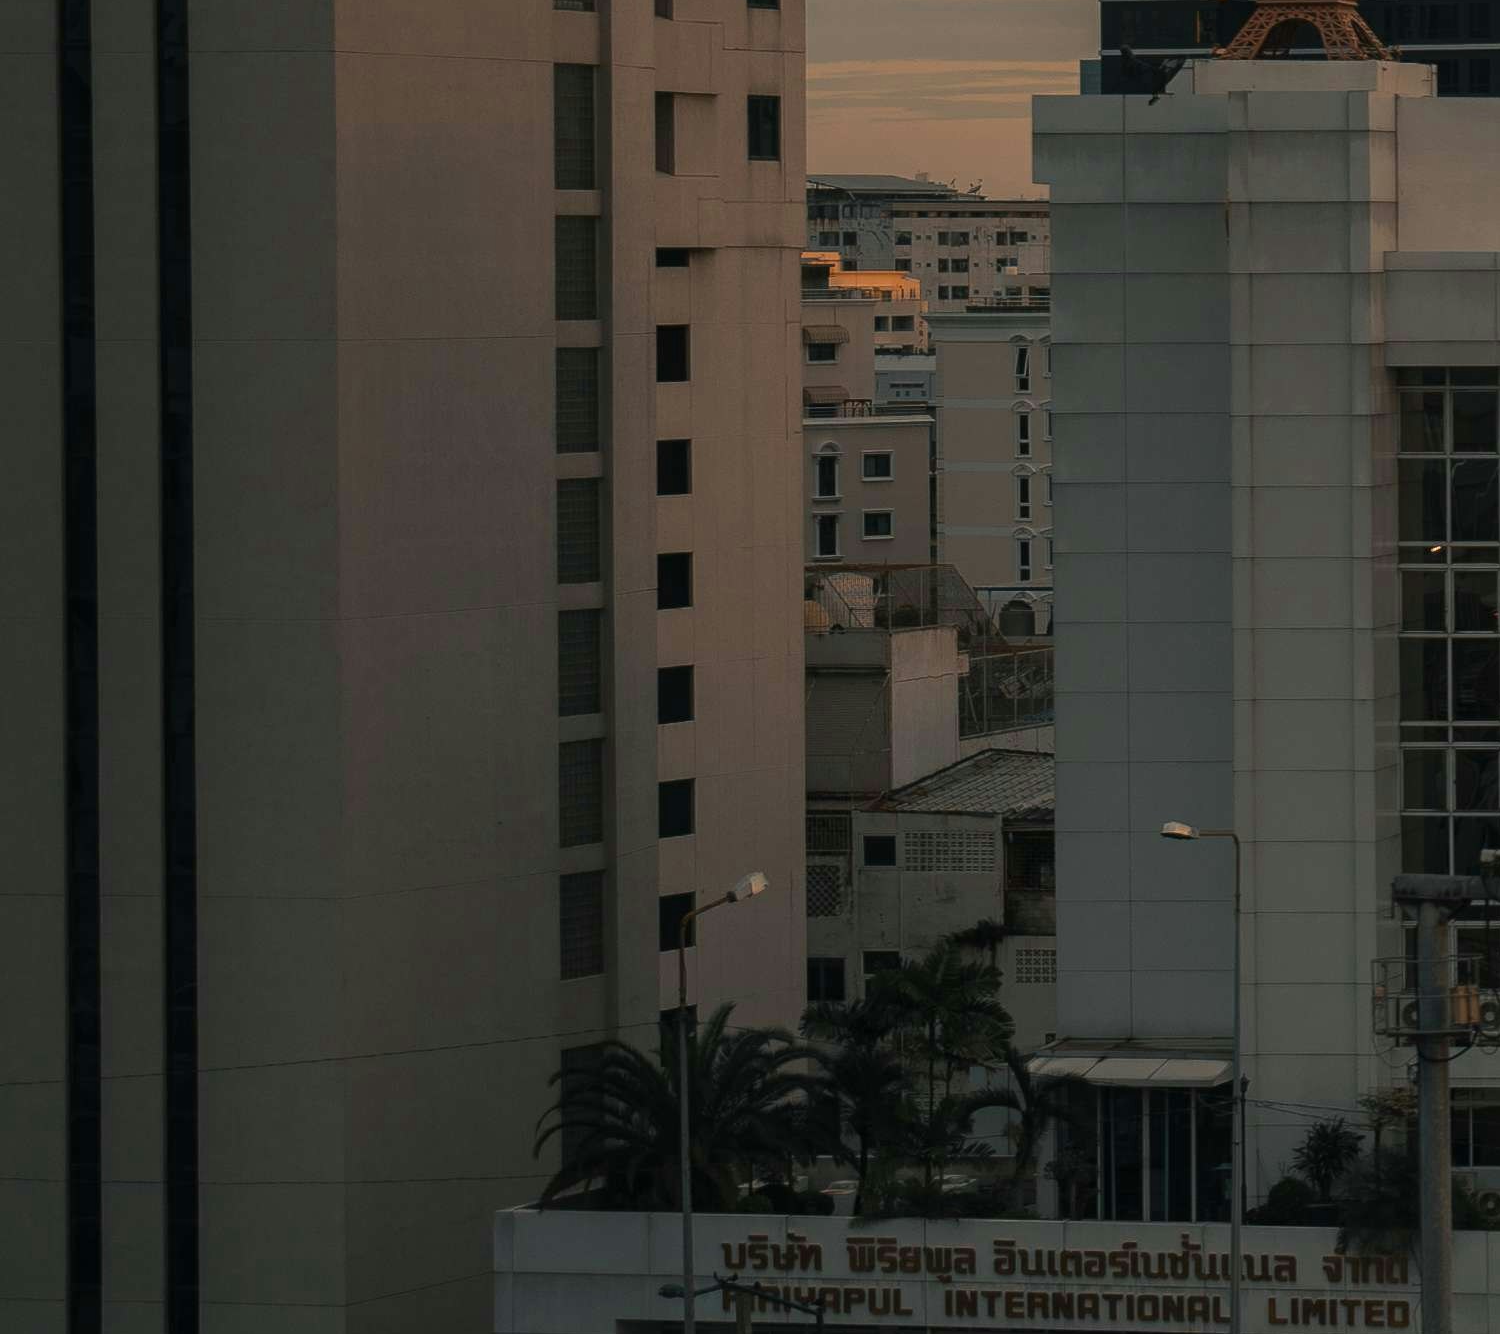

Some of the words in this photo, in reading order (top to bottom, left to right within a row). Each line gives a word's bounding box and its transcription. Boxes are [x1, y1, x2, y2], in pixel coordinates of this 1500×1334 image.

[720, 1227, 823, 1272] บริษัท
[846, 1236, 977, 1284] พิริยพูล
[721, 1284, 913, 1315] PRIYAPUL
[944, 1288, 1234, 1323] INTERNATIONAL
[1267, 1297, 1411, 1328] LIMITED
